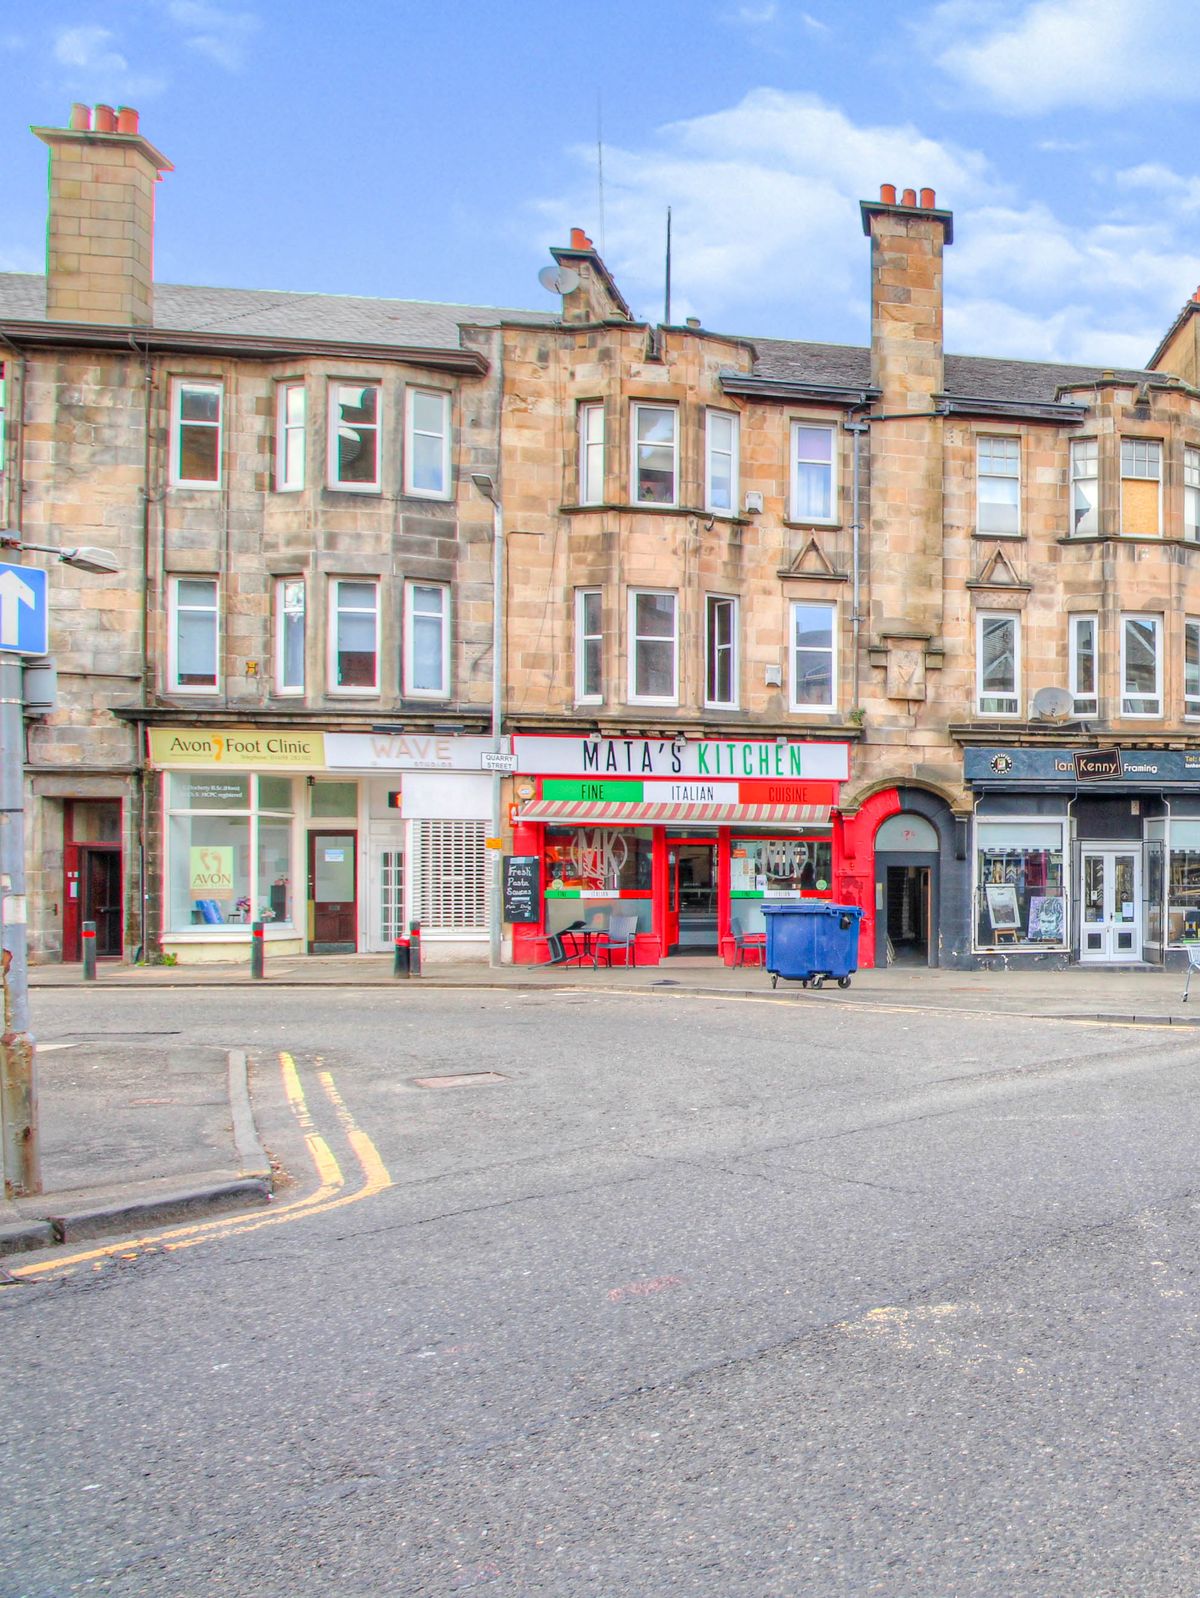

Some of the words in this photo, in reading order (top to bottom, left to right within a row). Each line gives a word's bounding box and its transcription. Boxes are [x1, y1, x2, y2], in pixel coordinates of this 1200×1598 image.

[170, 737, 212, 751] Avon
[226, 738, 261, 753] Foot
[266, 739, 311, 754] Clinic
[370, 737, 452, 760] WAVE
[485, 754, 513, 763] QUARRY
[583, 740, 682, 774] MATA'S
[698, 743, 801, 776] KITCHEN
[1055, 759, 1074, 771] Ian
[1080, 759, 1117, 774] Kenny
[1123, 763, 1158, 773] Framing
[581, 784, 604, 800] FINE
[671, 785, 714, 801] ITALIAN
[768, 787, 808, 803] CUISINE
[193, 873, 231, 885] AVON
